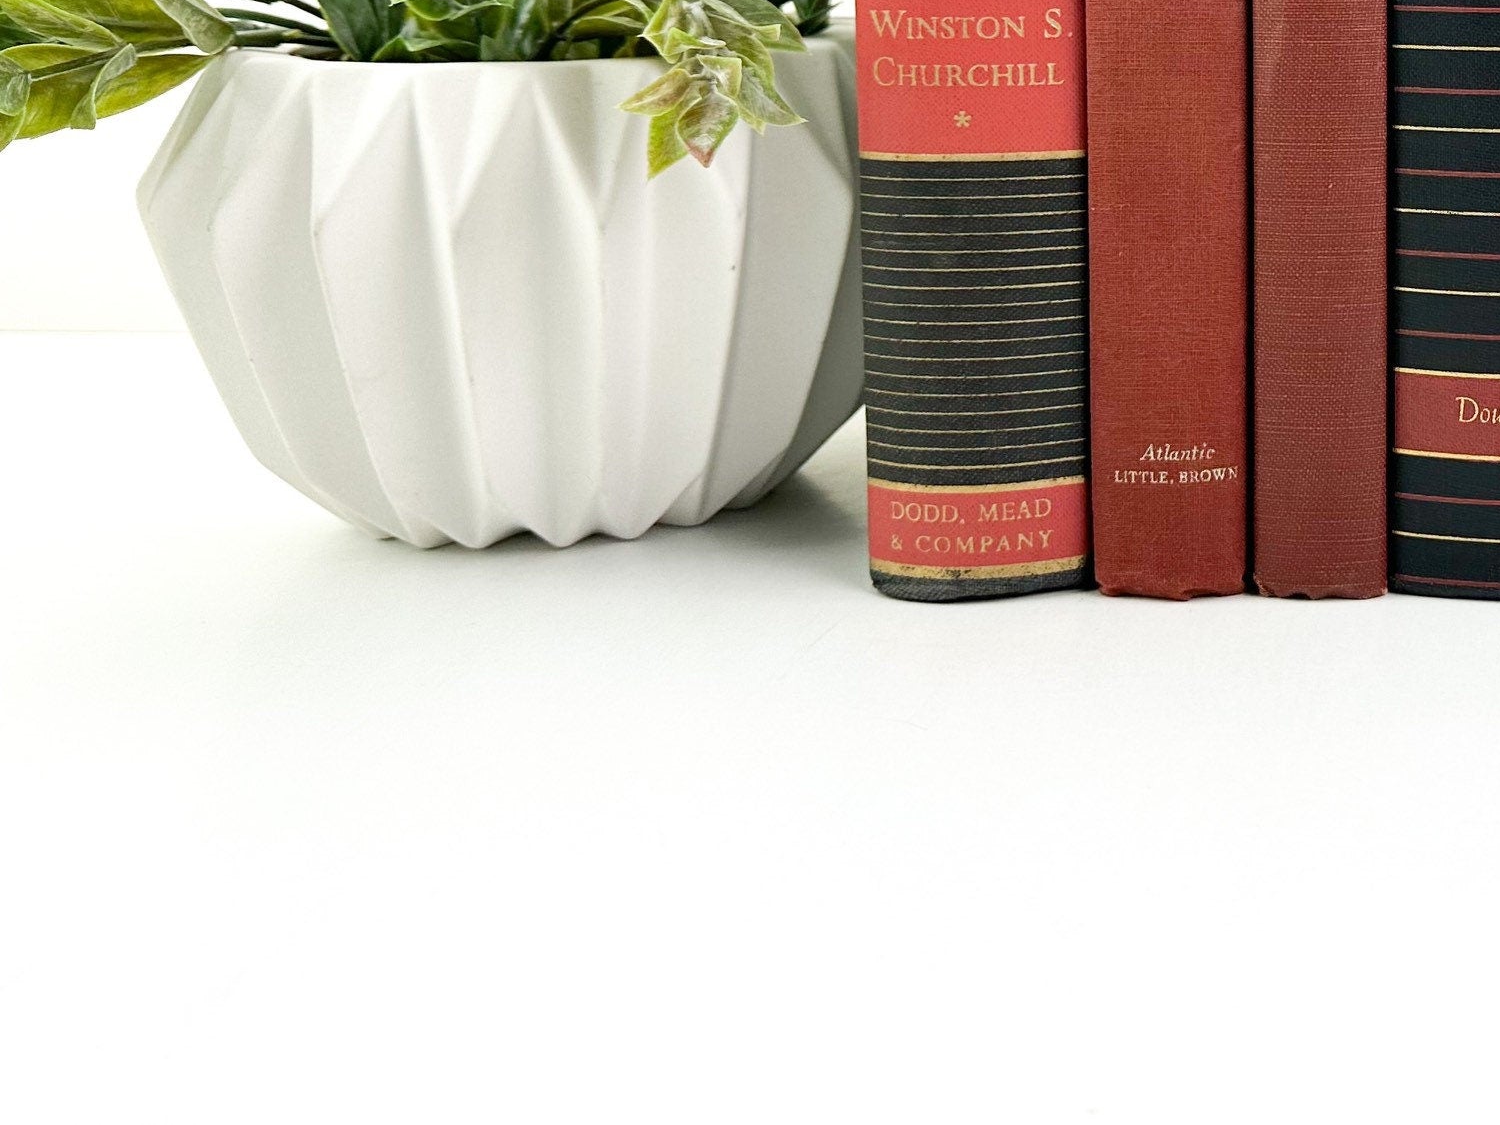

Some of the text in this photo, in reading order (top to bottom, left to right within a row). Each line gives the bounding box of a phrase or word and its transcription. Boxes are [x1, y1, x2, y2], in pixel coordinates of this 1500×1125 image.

[869, 8, 1073, 39] WINSTON S.
[873, 57, 1065, 87] CHURCHILL
[1140, 442, 1215, 461] Atlantic
[1114, 466, 1238, 484] LITTLE, BROWN
[890, 497, 1052, 525] DODD, MEAD
[891, 529, 1054, 554] & COMPANY
